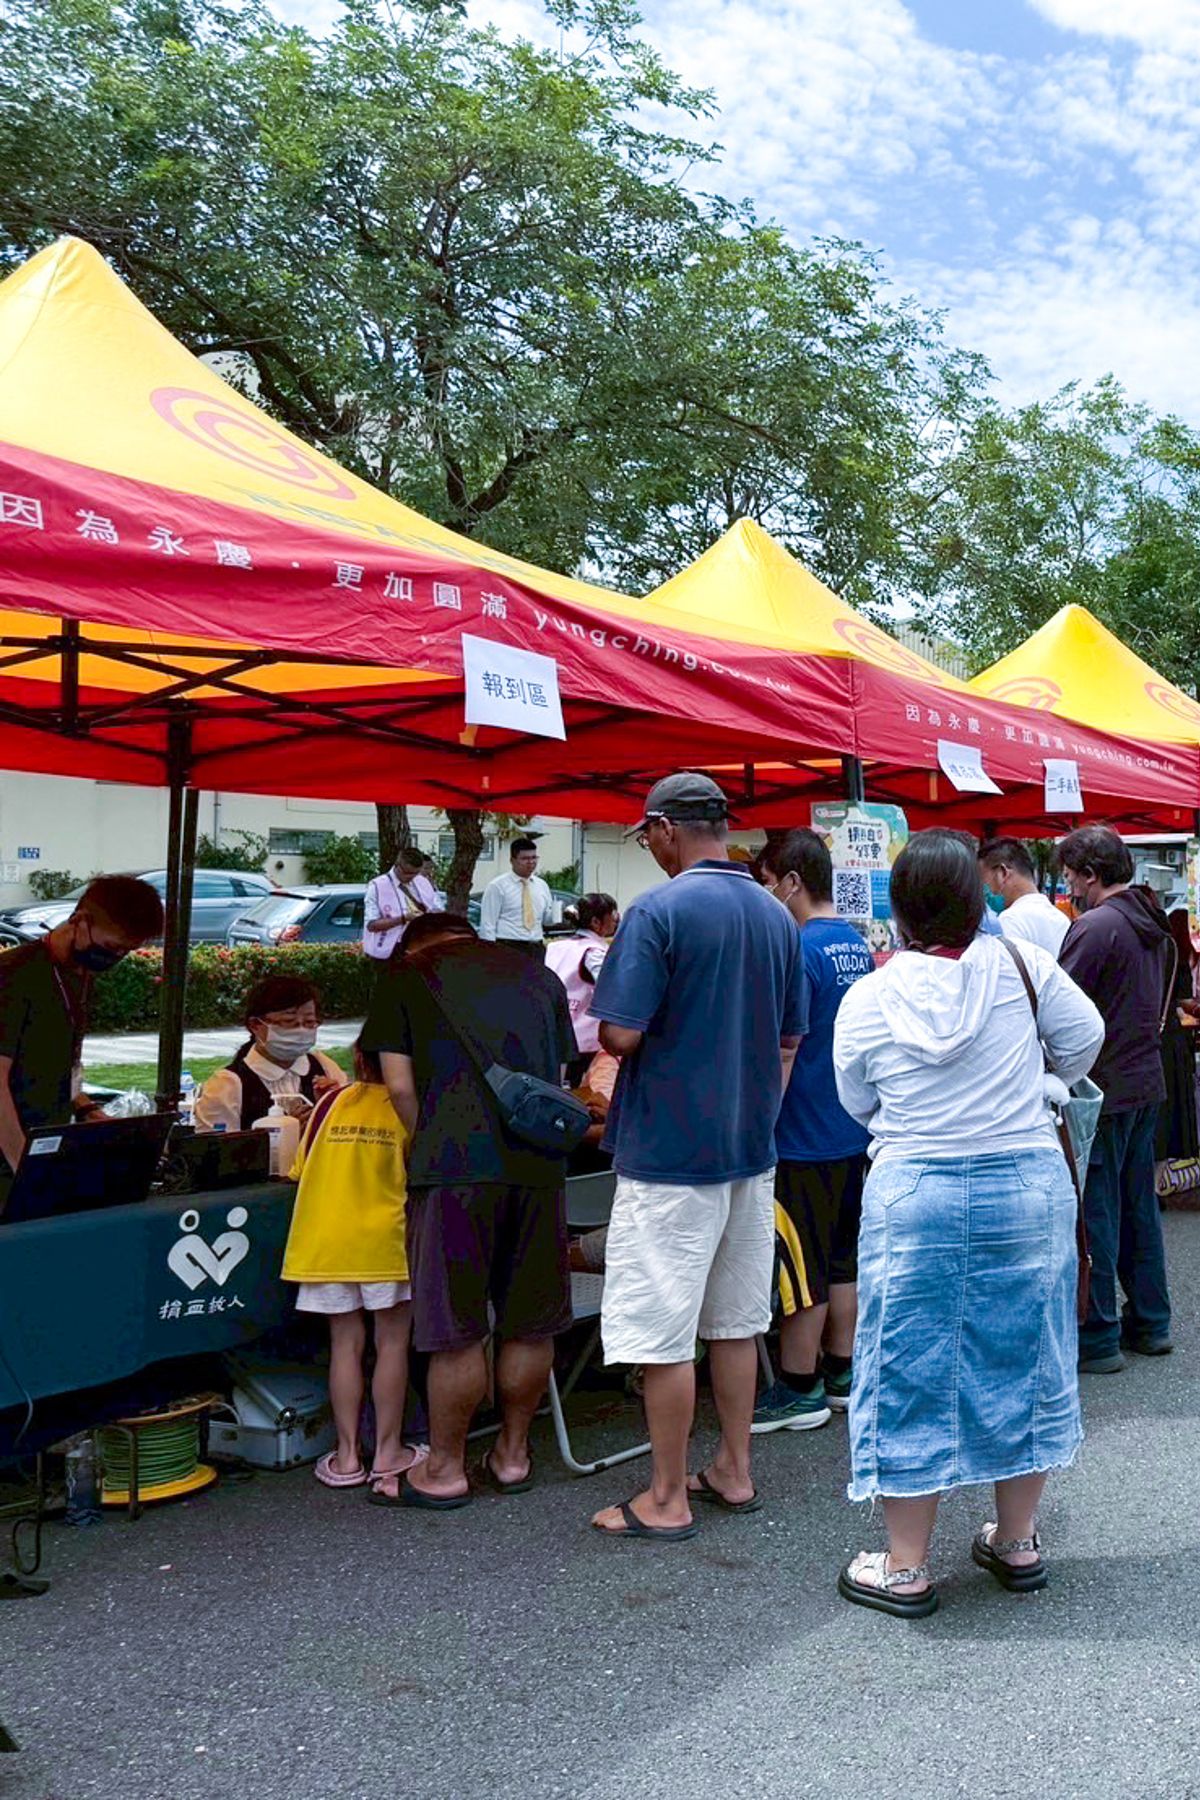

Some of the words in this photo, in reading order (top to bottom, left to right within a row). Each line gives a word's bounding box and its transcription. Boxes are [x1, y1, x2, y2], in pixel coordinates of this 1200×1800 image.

[482, 670, 549, 708] 報到區
[158, 1294, 245, 1319] 捐血救人
